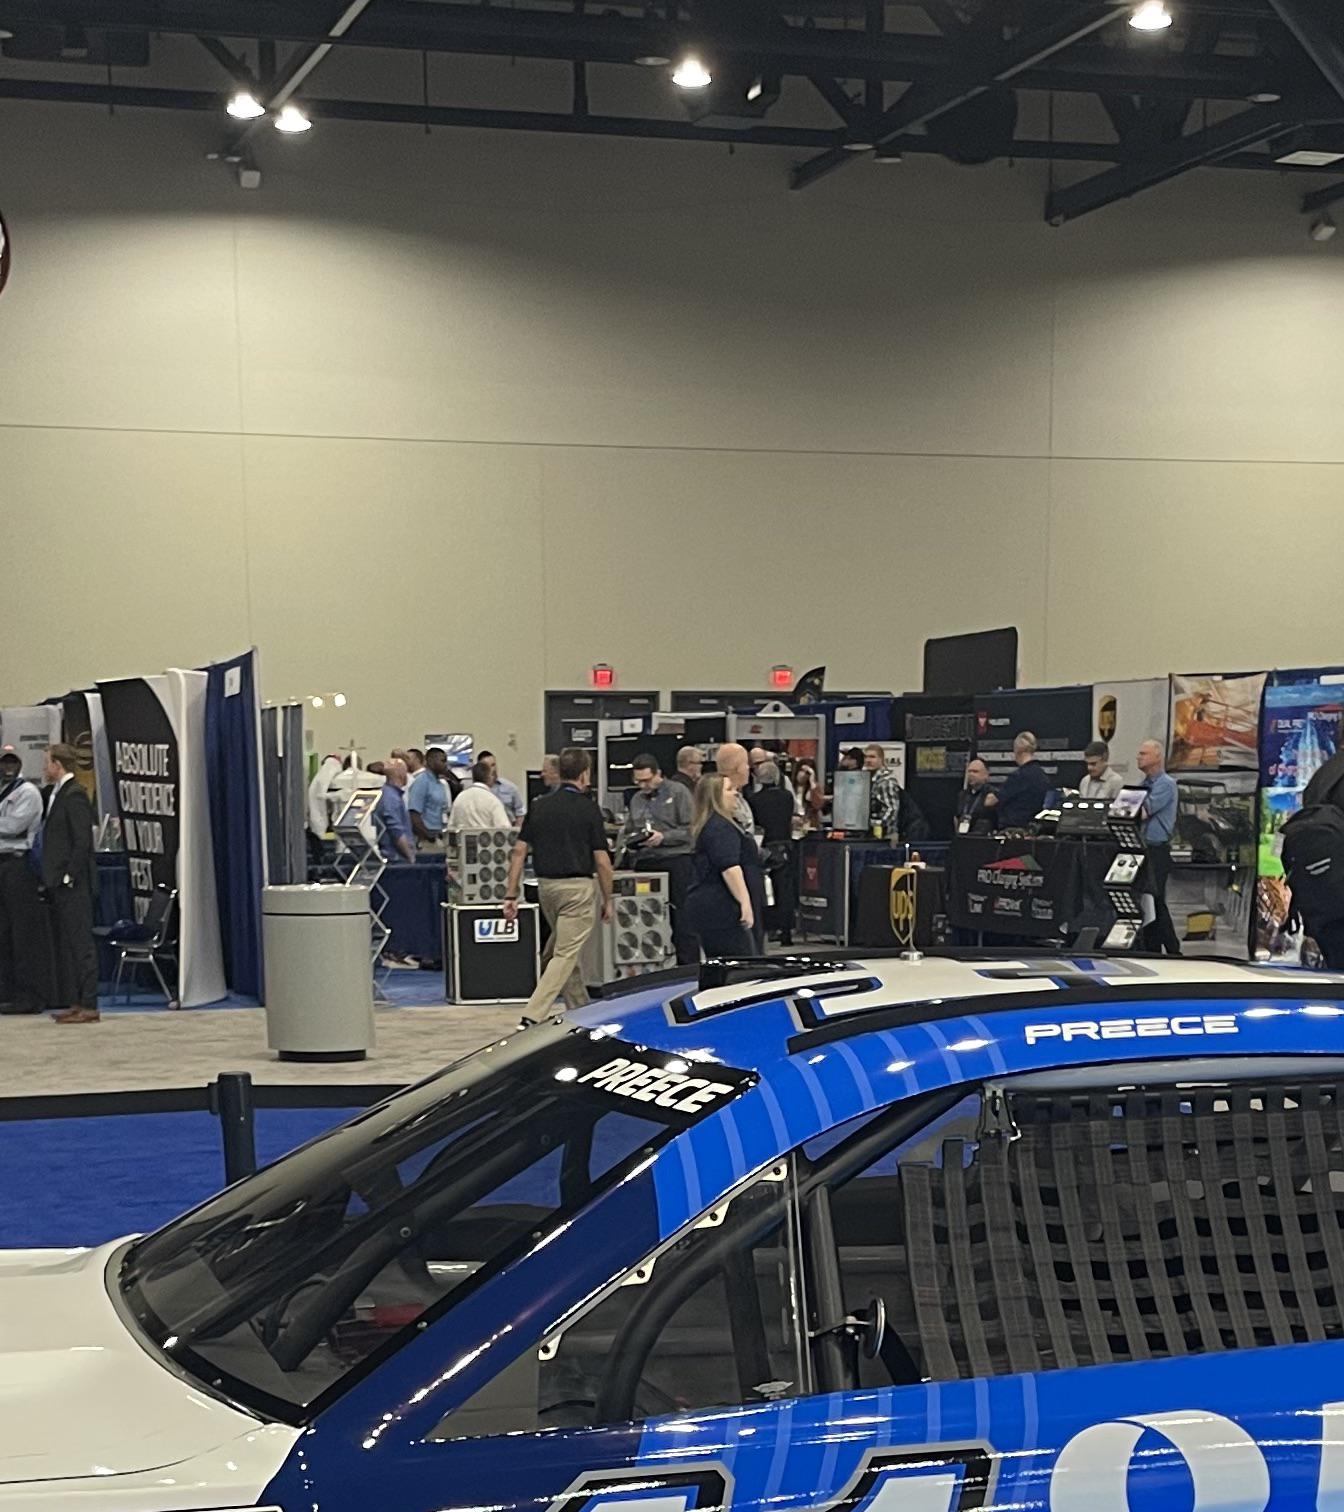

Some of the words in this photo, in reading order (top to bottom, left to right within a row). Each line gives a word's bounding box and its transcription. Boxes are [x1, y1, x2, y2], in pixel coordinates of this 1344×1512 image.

[115, 741, 170, 776] ABSOLUTE
[1025, 1015, 1239, 1045] PREECE
[578, 1057, 735, 1114] PREECE
